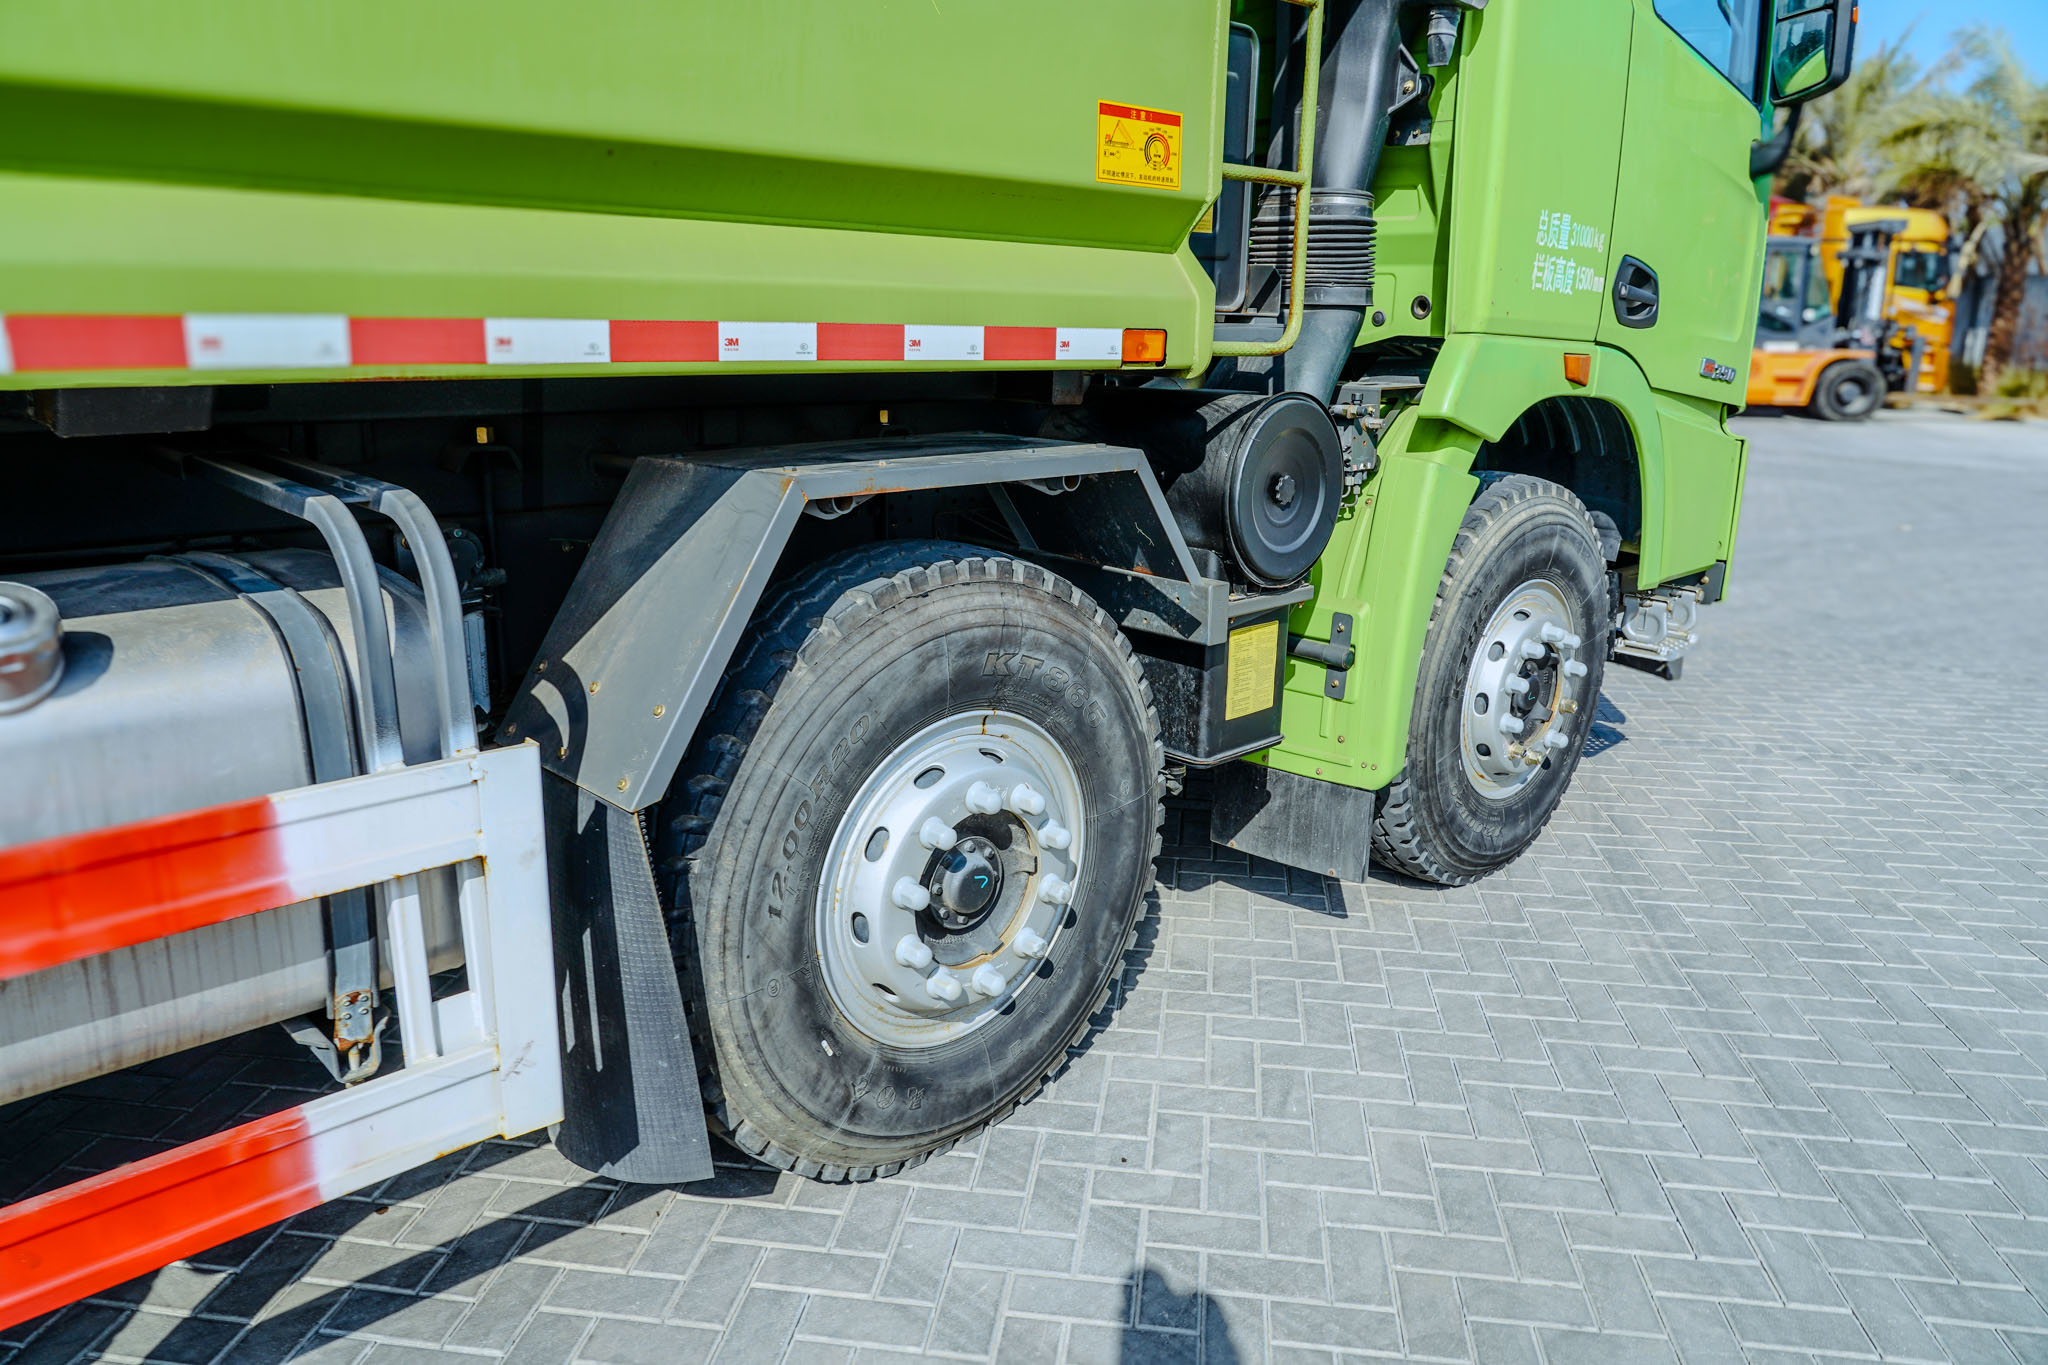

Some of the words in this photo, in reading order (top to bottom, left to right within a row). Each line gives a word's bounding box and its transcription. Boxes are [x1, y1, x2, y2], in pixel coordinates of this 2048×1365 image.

[724, 337, 739, 347] 3M
[908, 339, 921, 348] 3M
[1059, 340, 1070, 348] 3M
[977, 652, 1107, 729] KT865
